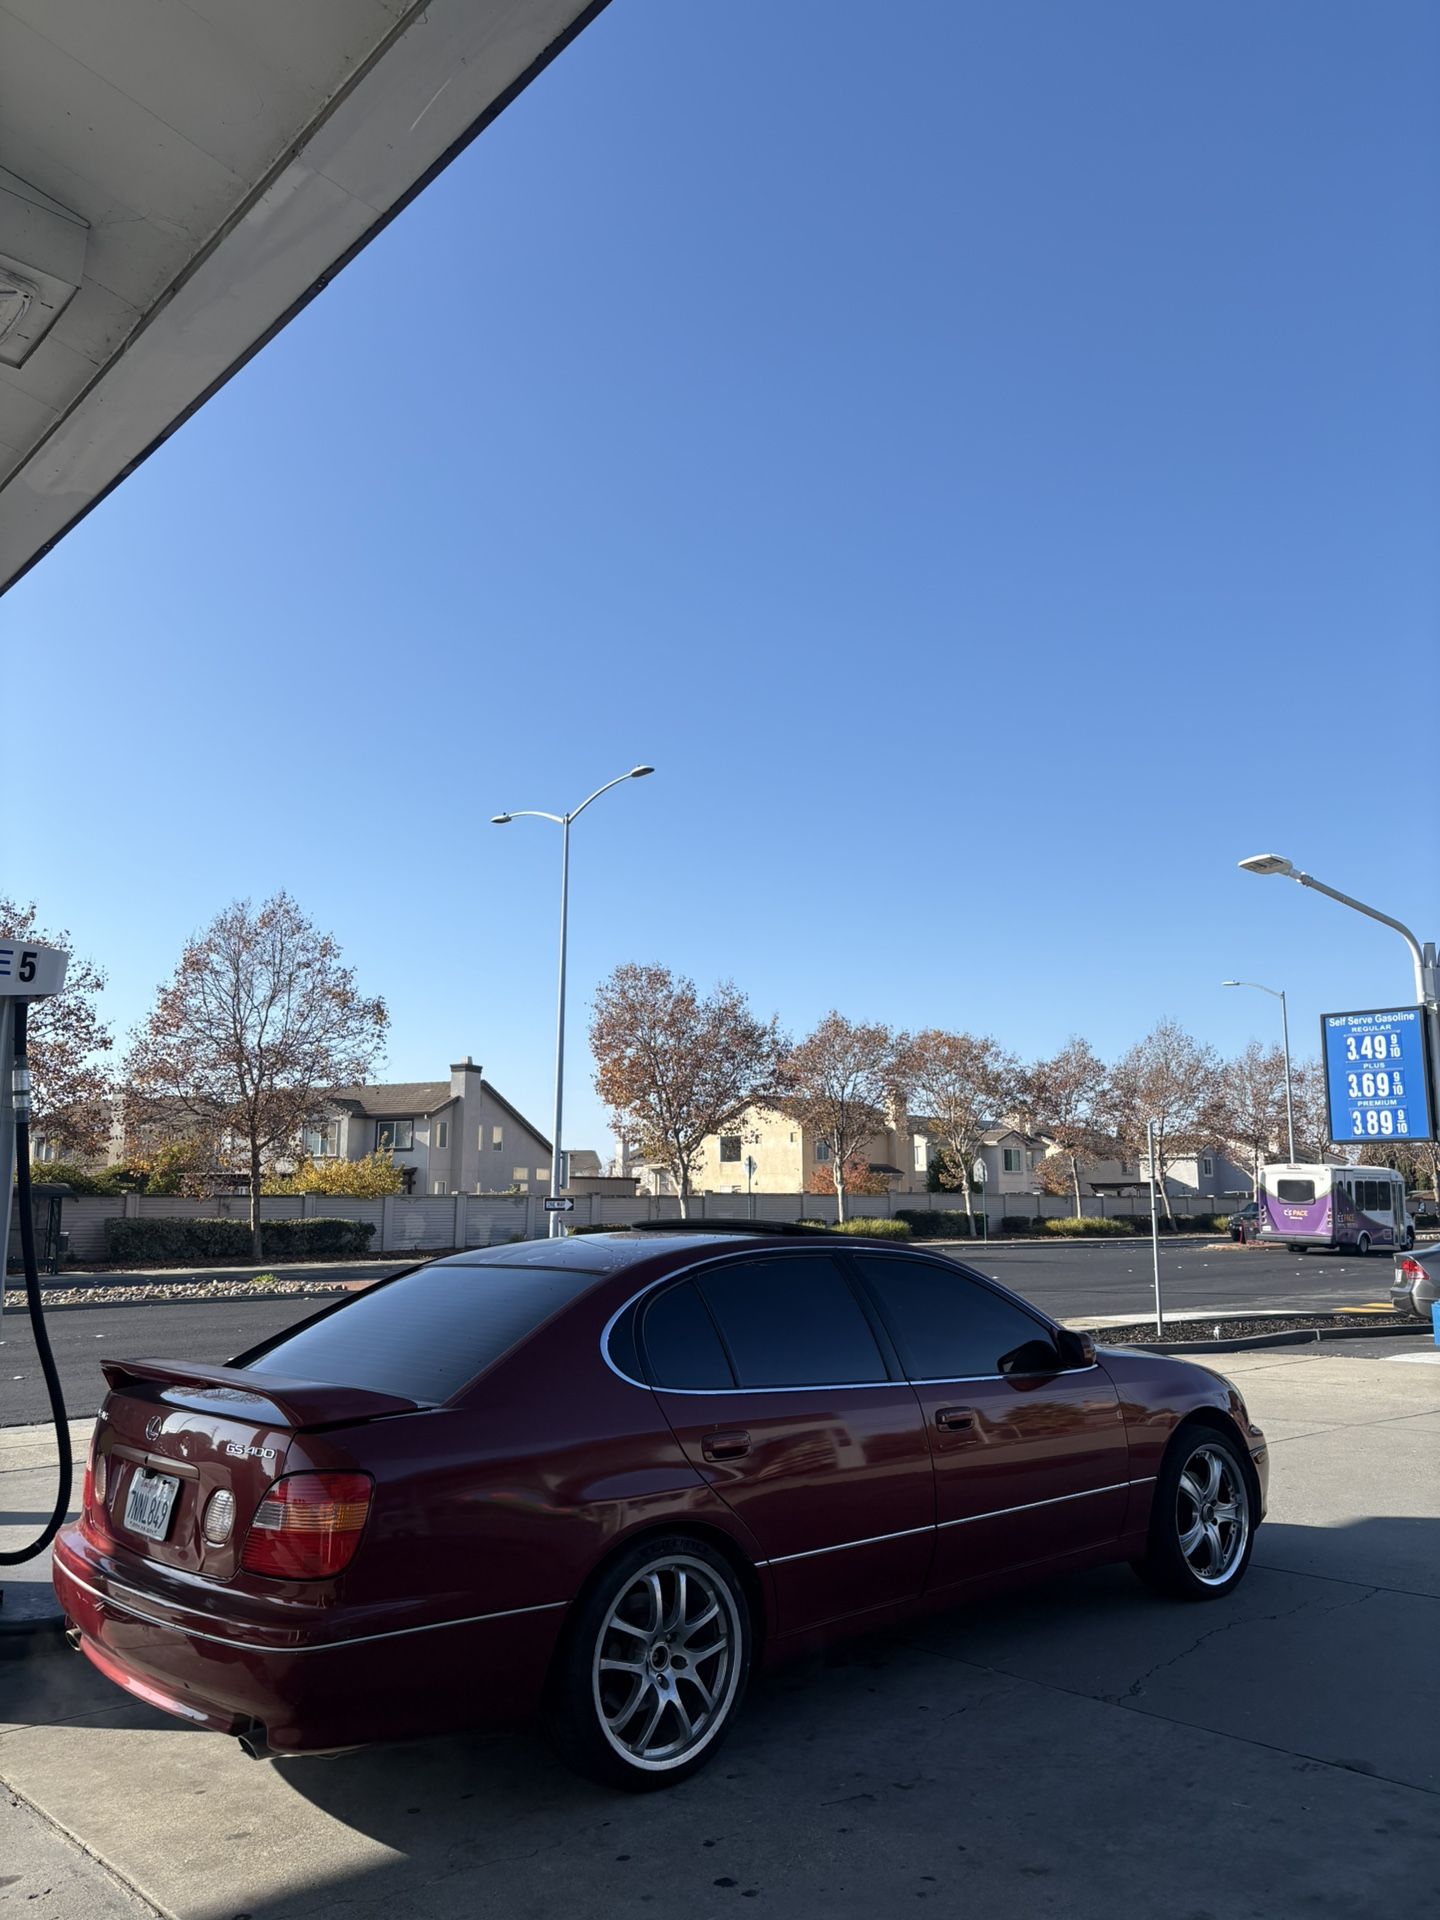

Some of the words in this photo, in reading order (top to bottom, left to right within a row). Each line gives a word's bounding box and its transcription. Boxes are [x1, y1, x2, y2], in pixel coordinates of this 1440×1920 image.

[19, 951, 37, 982] 5
[1329, 1017, 1346, 1027] Self
[1348, 1015, 1373, 1024] Serve
[1375, 1013, 1415, 1023] Gasoline
[1352, 1024, 1392, 1032] REGULAR
[1346, 1035, 1386, 1060] 3.49
[1348, 1072, 1390, 1098] 3.69
[1357, 1099, 1398, 1107] PREMIUM
[1352, 1110, 1393, 1135] 3.89
[226, 1443, 245, 1455] GS
[246, 1446, 275, 1459] 400
[128, 1490, 168, 1530] 7NNL849
